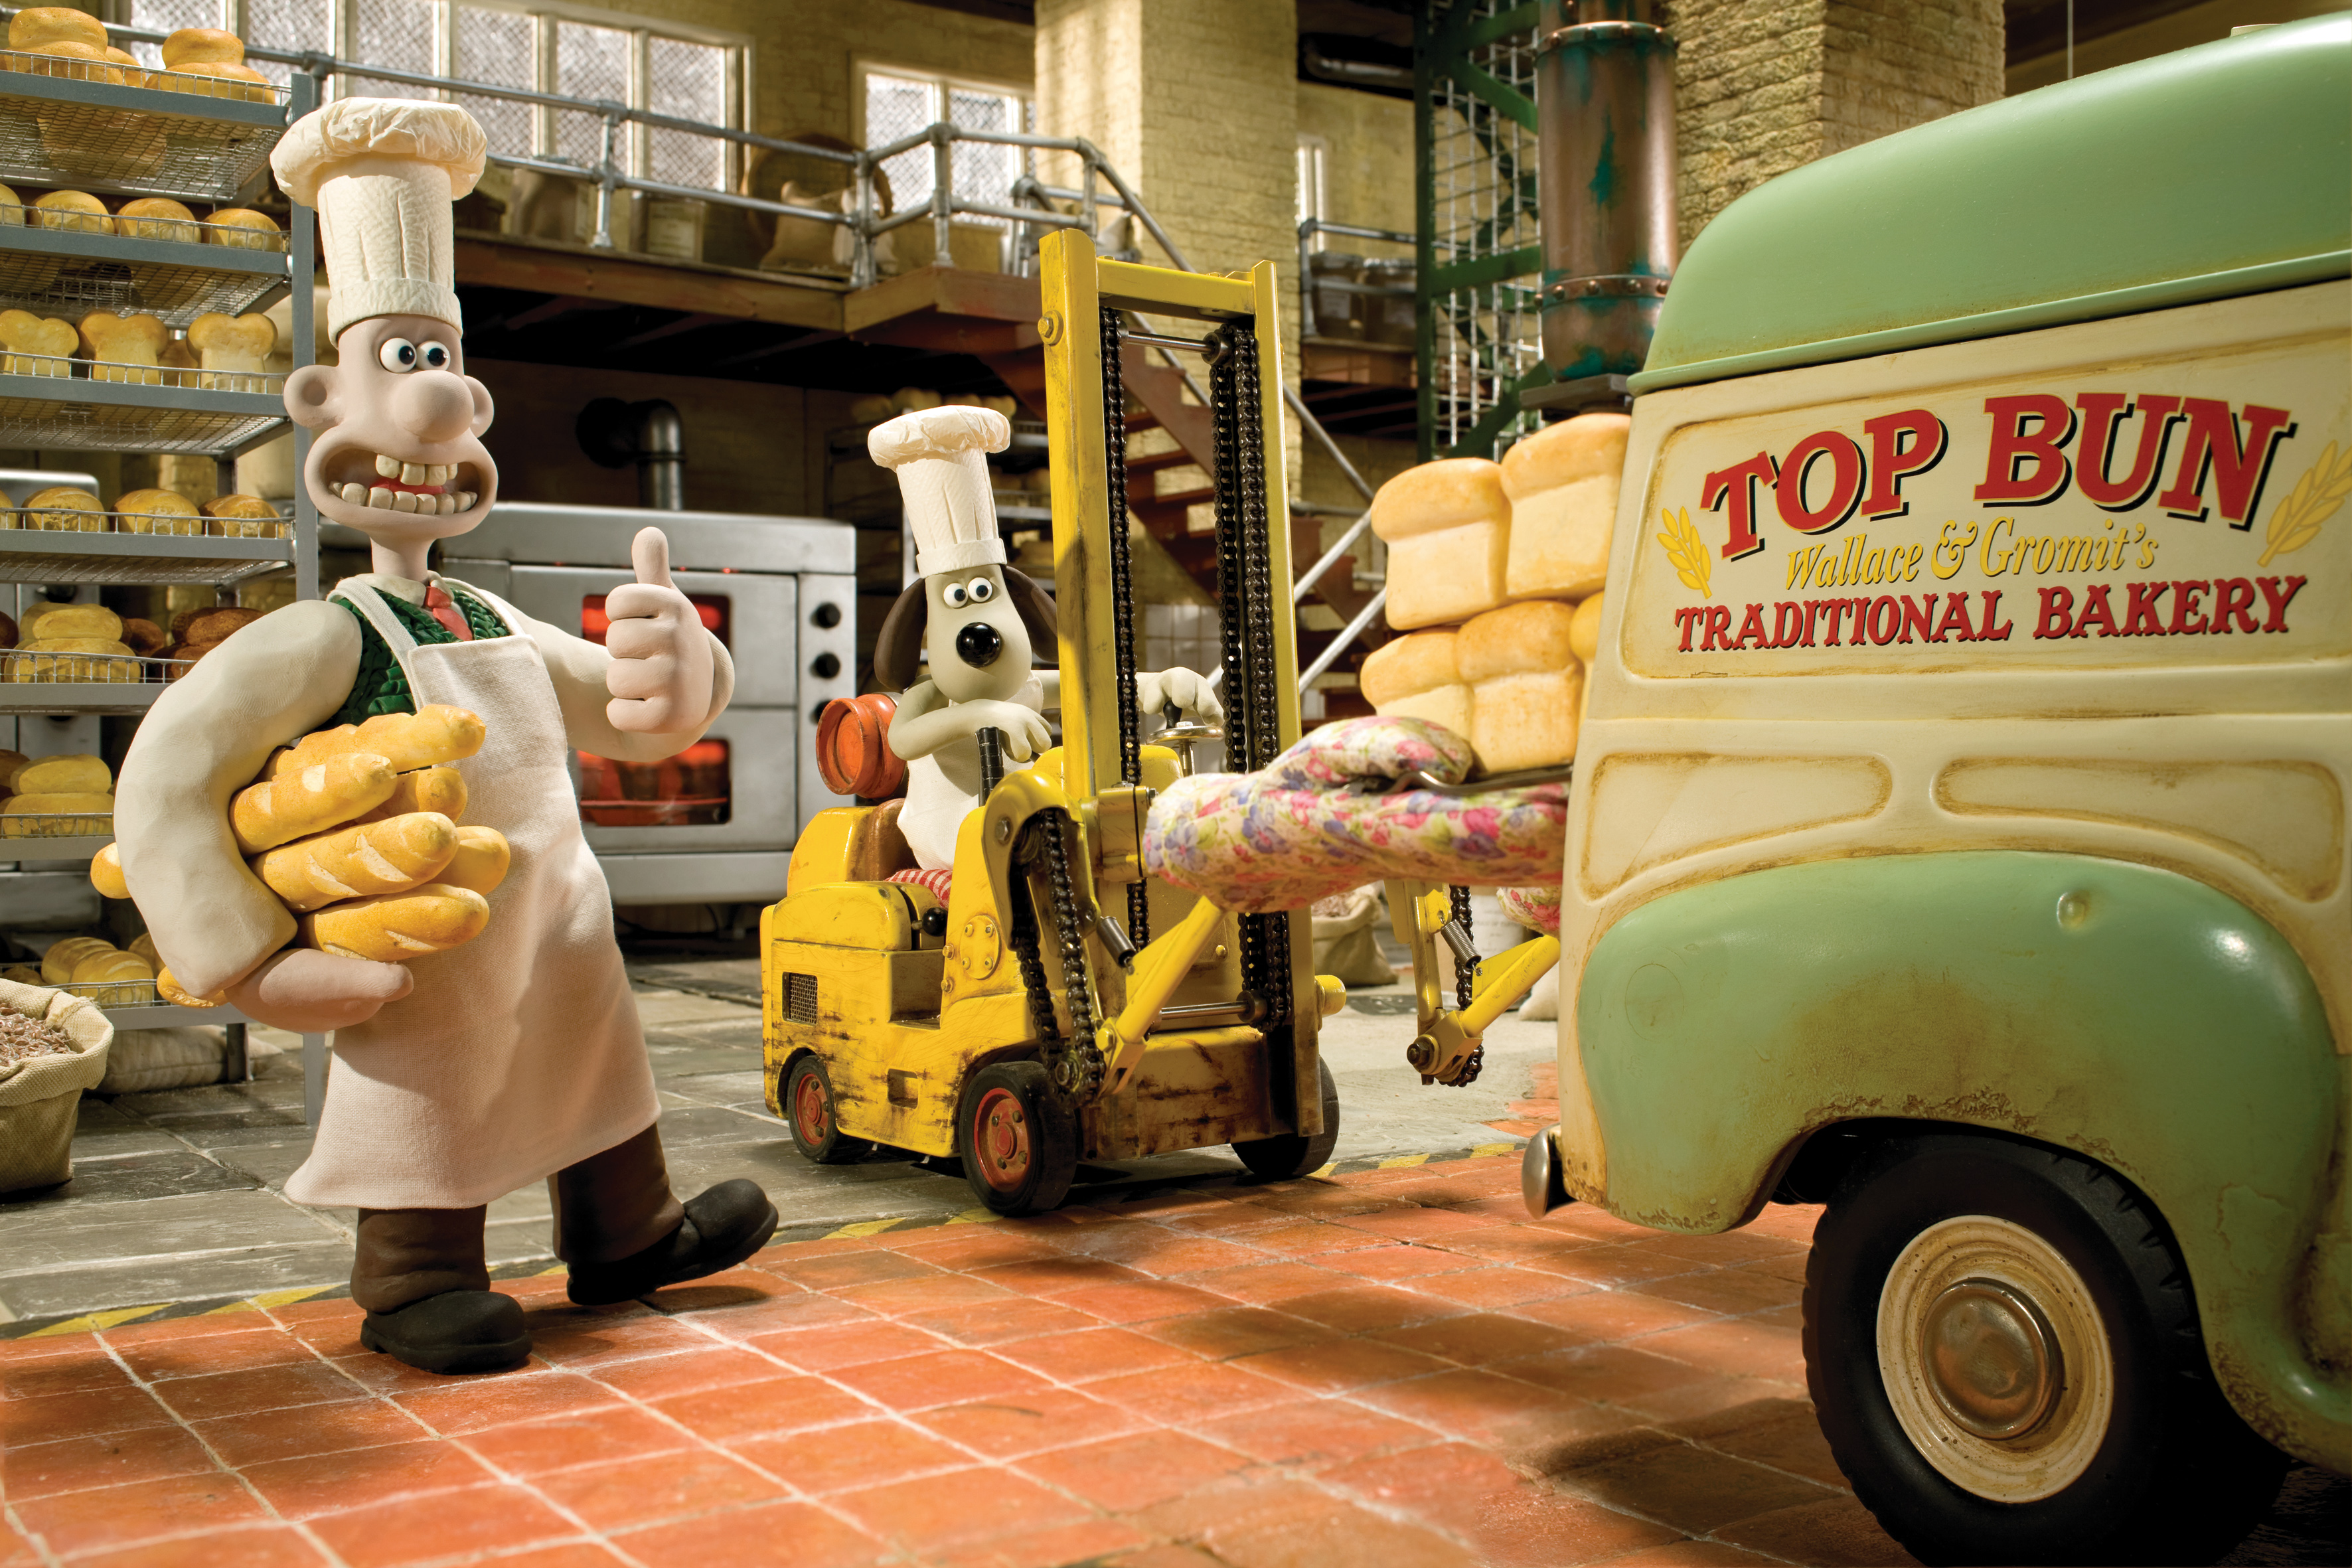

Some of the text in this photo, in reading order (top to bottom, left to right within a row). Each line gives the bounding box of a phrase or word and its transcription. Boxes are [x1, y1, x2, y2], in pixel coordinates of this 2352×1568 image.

[1699, 392, 2298, 562] TOP BUN
[1785, 516, 2159, 590] Wallace & Gromit's
[1674, 575, 2308, 653] TRADITIONAL BAKERY
